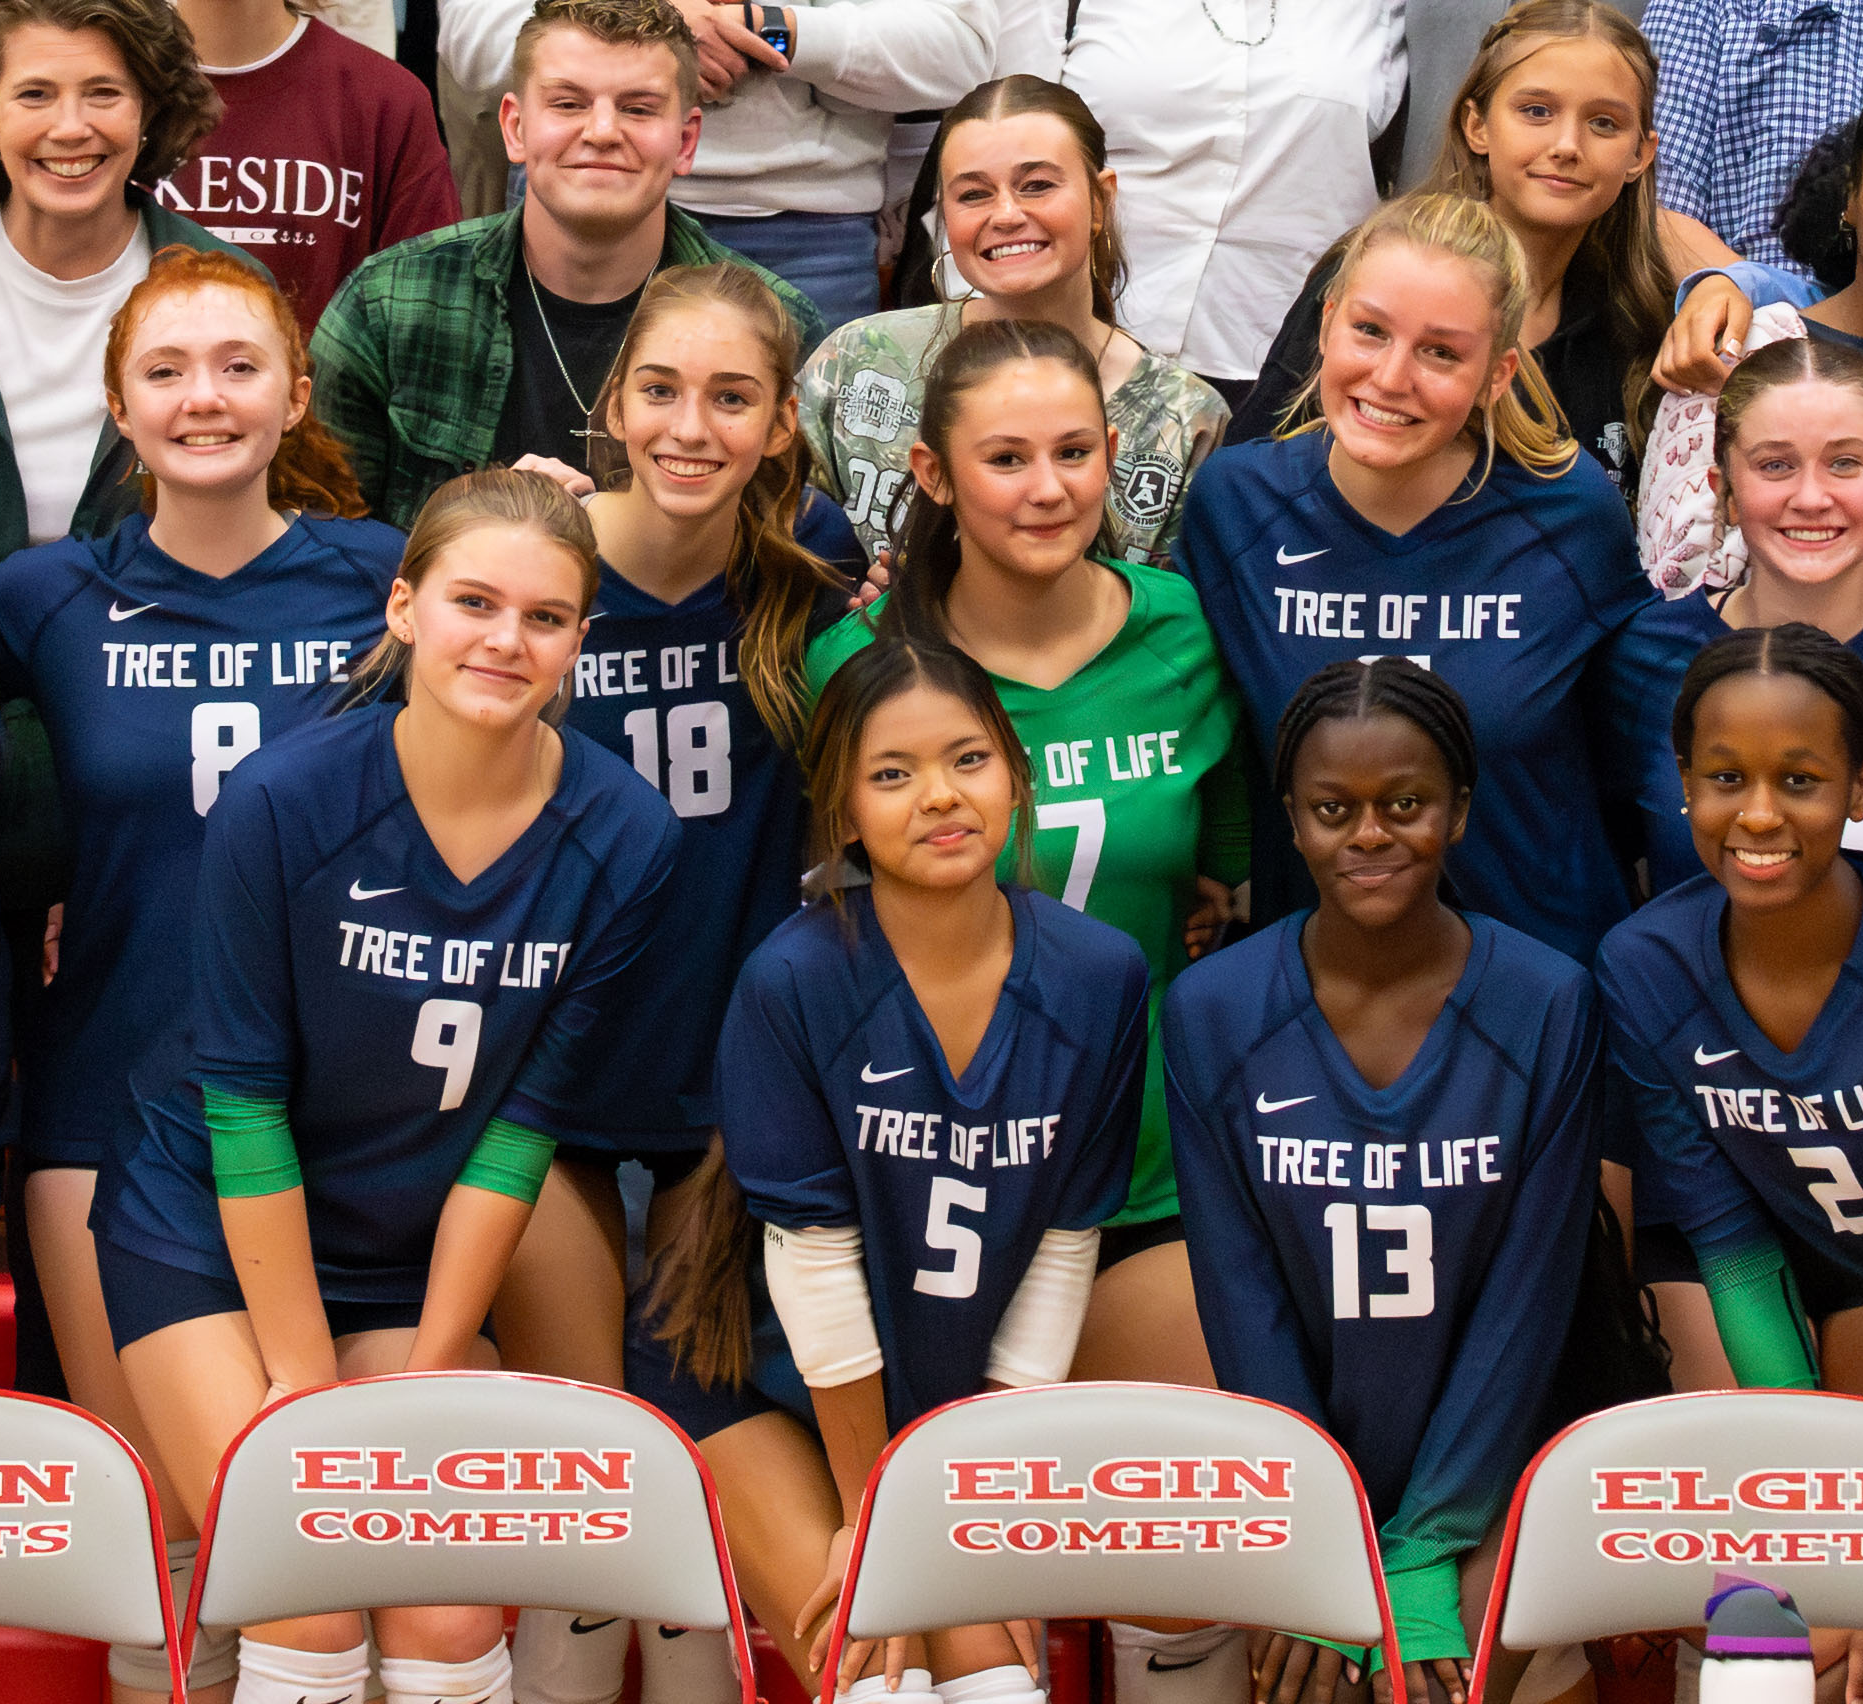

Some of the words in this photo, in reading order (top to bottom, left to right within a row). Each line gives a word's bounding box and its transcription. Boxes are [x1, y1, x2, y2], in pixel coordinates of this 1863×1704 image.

[154, 156, 365, 228] KESIDE
[840, 385, 857, 399] OS
[858, 386, 920, 424] ANGELES
[843, 401, 901, 432] STUDIOS
[1274, 586, 1367, 639] TREE
[1378, 594, 1428, 639] OF
[1439, 594, 1522, 639] LIFE
[102, 643, 197, 688] TREE
[209, 643, 259, 686] OF
[271, 640, 351, 685] LIFE
[574, 649, 648, 698] REE
[660, 643, 707, 690] OF
[624, 701, 731, 818] 18
[1044, 739, 1093, 787] OF
[1105, 730, 1183, 781] LIFE
[1035, 798, 1106, 912] 7
[339, 920, 432, 981] TREE
[442, 939, 493, 985] OF
[410, 998, 483, 1112] 9
[1694, 1085, 1787, 1133] TREE
[1787, 1094, 1828, 1131] OF
[856, 1104, 942, 1159] TREE
[949, 1121, 990, 1171] OF
[992, 1113, 1061, 1168] LIFE
[1257, 1135, 1352, 1187] TREE
[1363, 1143, 1406, 1189] OF
[1419, 1136, 1502, 1188] LIFE
[912, 1176, 987, 1299] 5
[1323, 1202, 1435, 1319] 13
[291, 1446, 635, 1495] ELGIN
[943, 1456, 1295, 1504] ELGIN
[295, 1507, 632, 1545] COMETS
[947, 1516, 1291, 1555] COMETS
